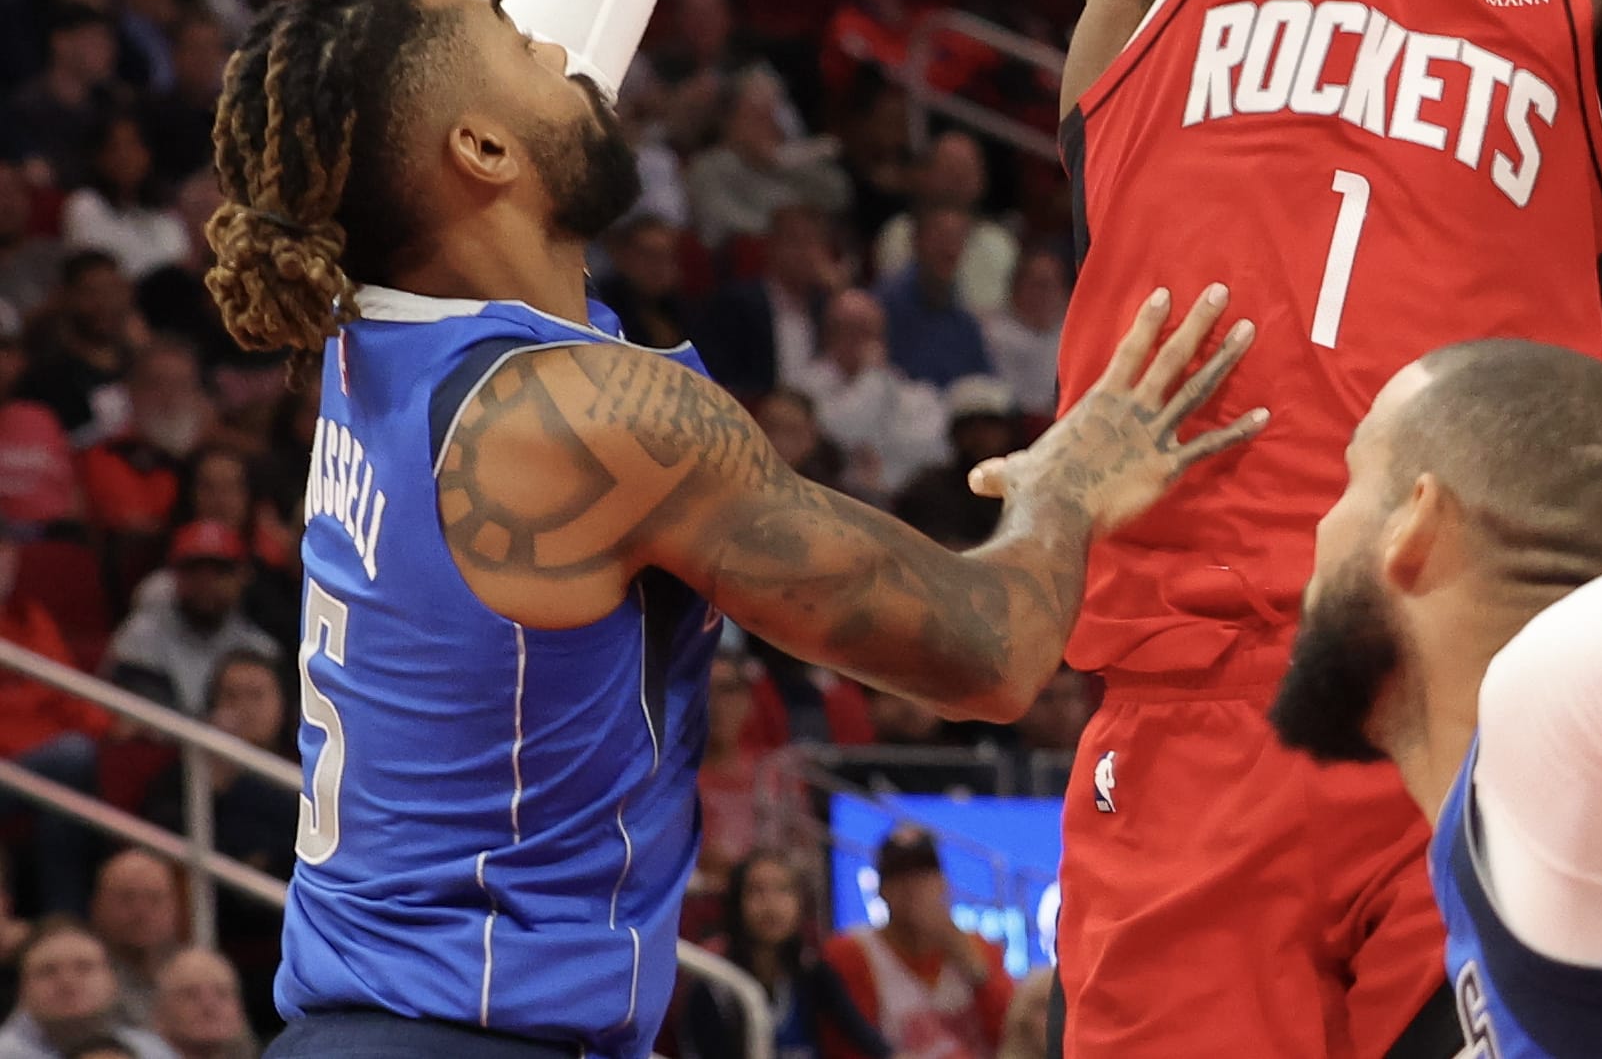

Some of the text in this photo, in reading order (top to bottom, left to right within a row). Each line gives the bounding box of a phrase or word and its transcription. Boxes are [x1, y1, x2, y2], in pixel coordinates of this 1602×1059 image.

[1311, 169, 1371, 349] 1
[304, 416, 386, 581] USSELL
[296, 577, 348, 865] 5
